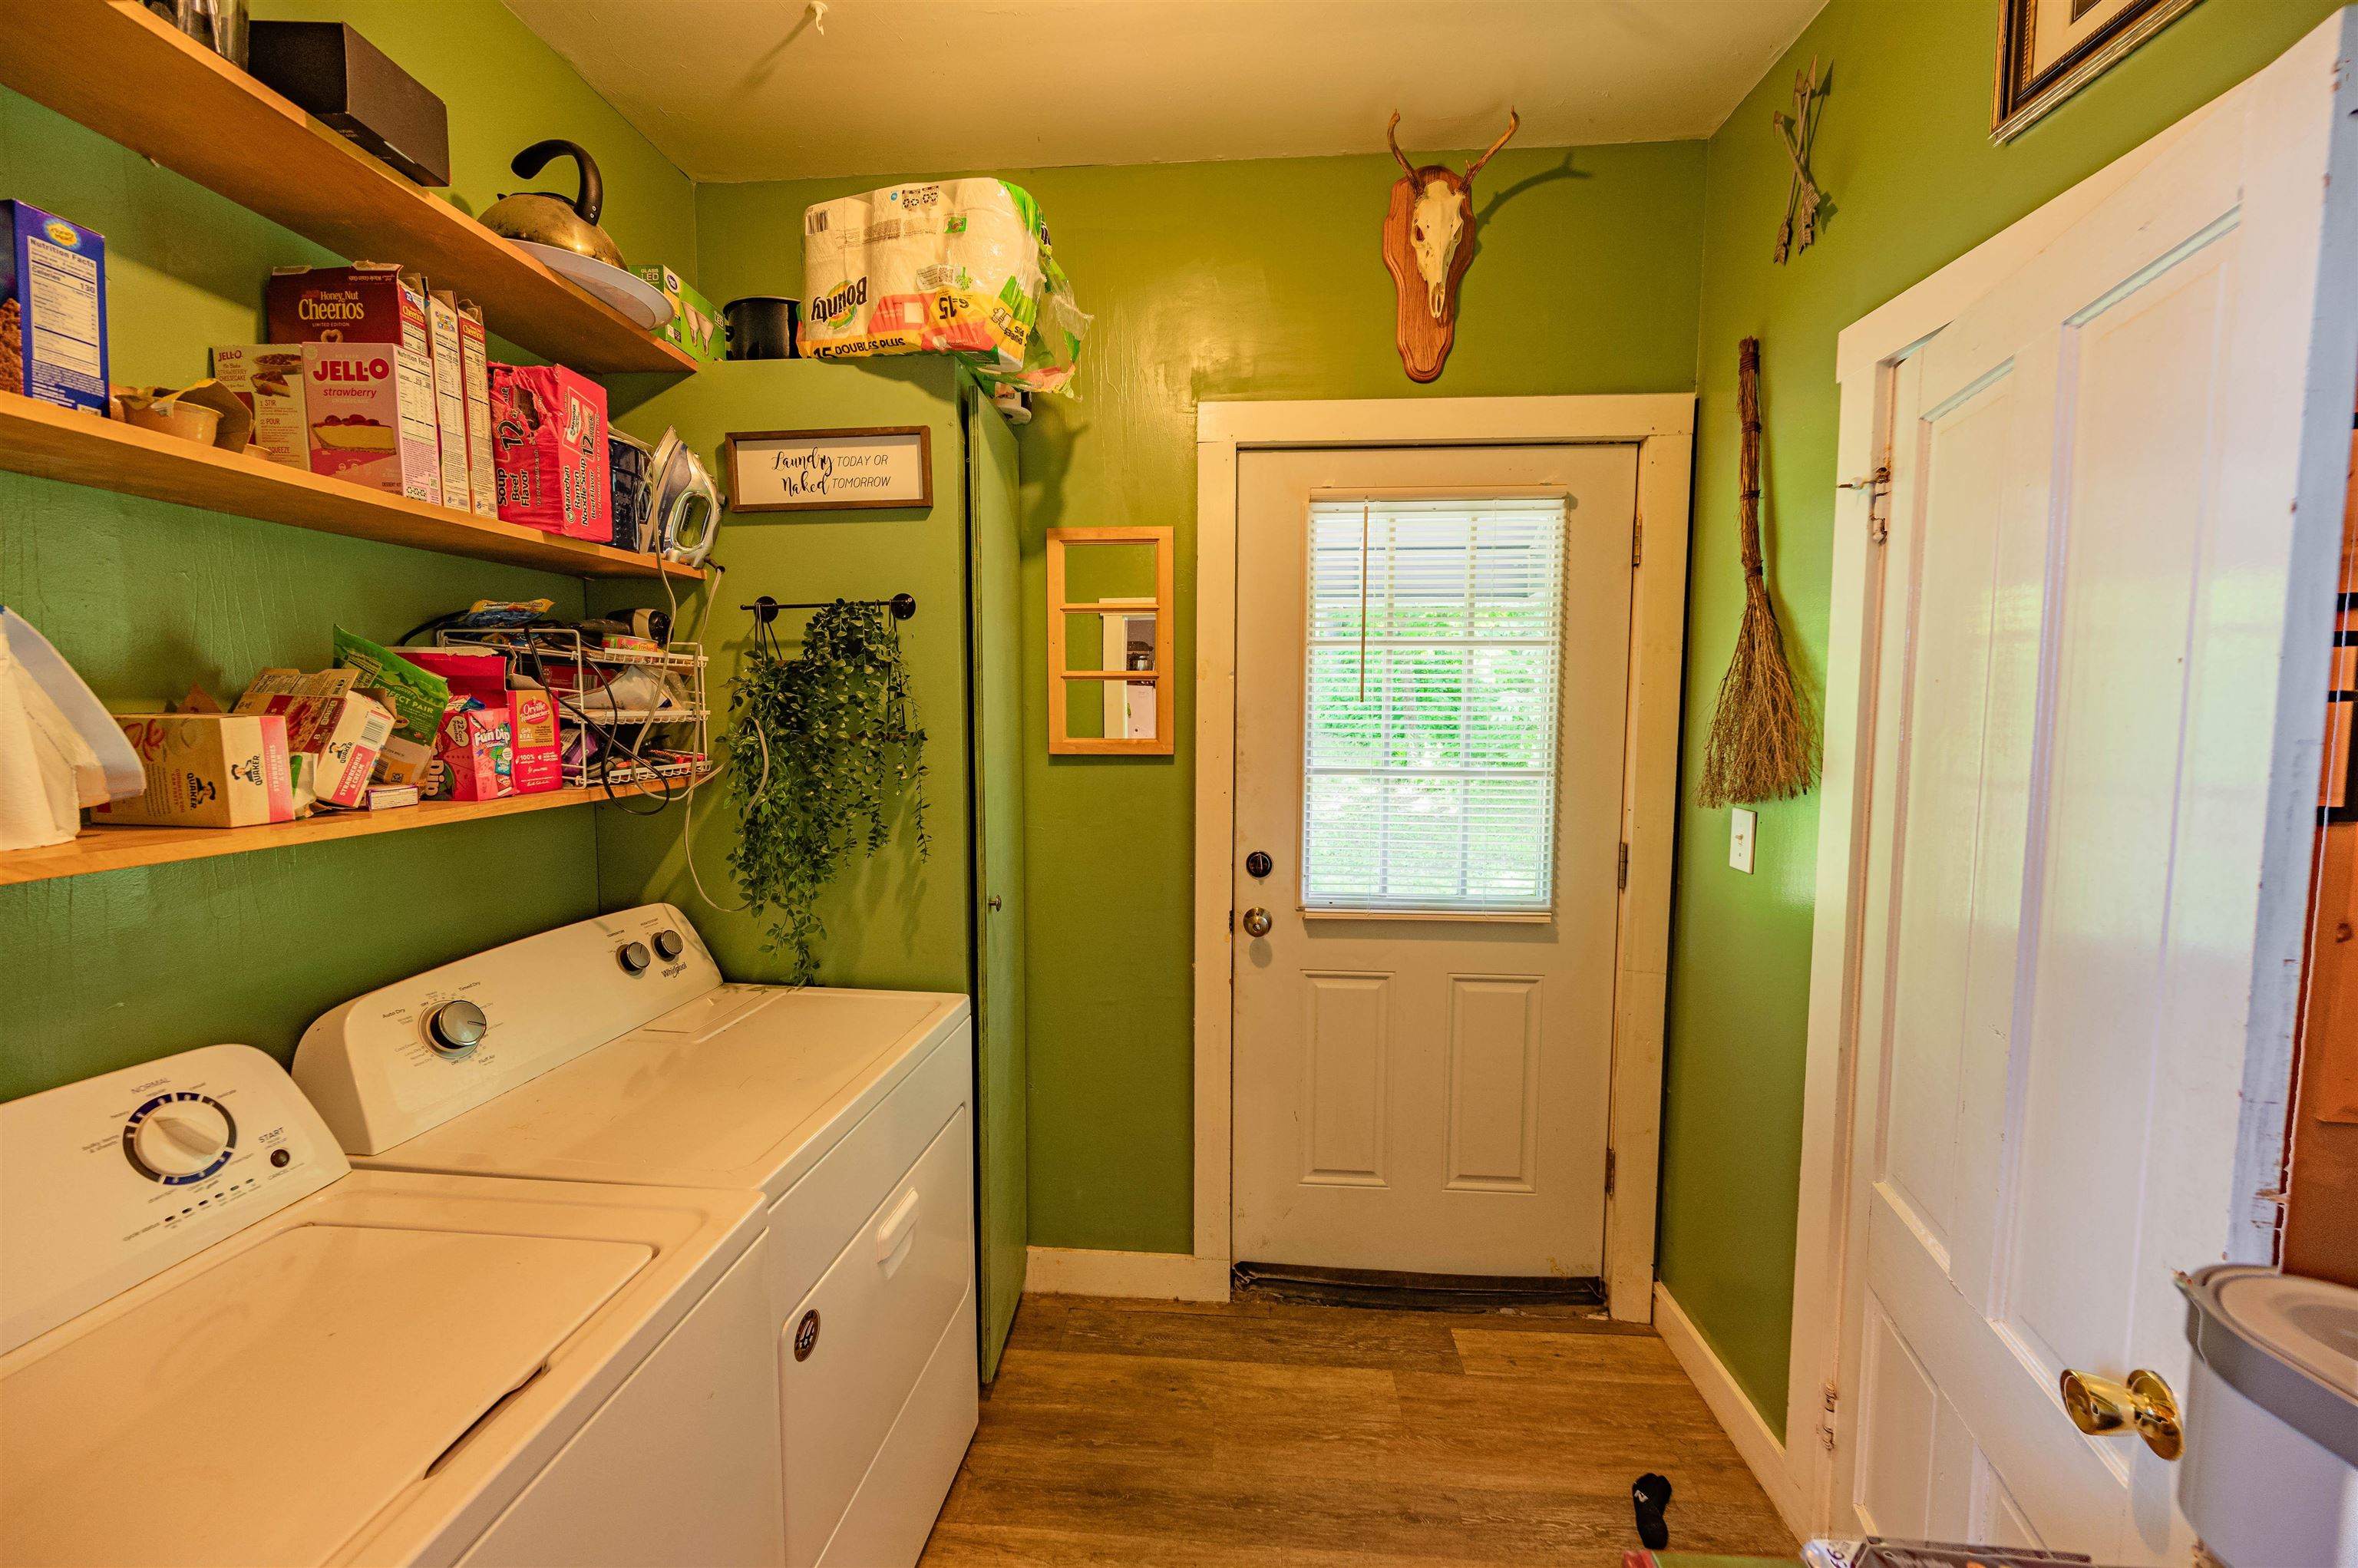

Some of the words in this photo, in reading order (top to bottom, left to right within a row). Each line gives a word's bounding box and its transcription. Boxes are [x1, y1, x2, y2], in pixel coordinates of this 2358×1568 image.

[31, 239, 70, 258] Nutrition
[72, 254, 94, 267] Facts
[31, 267, 61, 281] Calories
[80, 282, 95, 293] 130
[320, 291, 343, 301] Honey
[345, 290, 358, 300] Nut
[298, 298, 365, 321] Cheerios
[811, 276, 868, 323] Bounty
[879, 338, 907, 348] PLUS
[397, 349, 418, 364] Nutrition
[323, 387, 377, 398] strawberry
[497, 420, 524, 451] 12
[581, 434, 594, 457] 12
[580, 457, 588, 486] Soup
[771, 447, 834, 477] Laundry
[837, 455, 871, 467] TODAY
[874, 454, 889, 466] OR
[497, 468, 508, 507] Soup
[510, 474, 520, 502] Beef
[520, 470, 530, 507] Flavor
[564, 466, 573, 512] Maruchan
[781, 470, 830, 497] Naked
[832, 476, 891, 489] TOMORROW
[580, 487, 590, 526] Noodle
[412, 701, 434, 714] PAIR
[523, 701, 546, 715] Orville
[457, 720, 464, 729] 22
[474, 729, 495, 748] Fun
[495, 726, 511, 745] Dip
[339, 741, 353, 764] QUAKER
[253, 755, 263, 786] QUAKER
[269, 744, 278, 792] STRAWBERRIES
[339, 751, 363, 797] STRAWBERRIES
[352, 763, 365, 784] CREAM
[187, 772, 198, 809] QUAKER
[661, 961, 689, 979] Whirlpool
[381, 1011, 395, 1019] Auto
[130, 1078, 172, 1094] NORMAL
[258, 1127, 284, 1144] START
